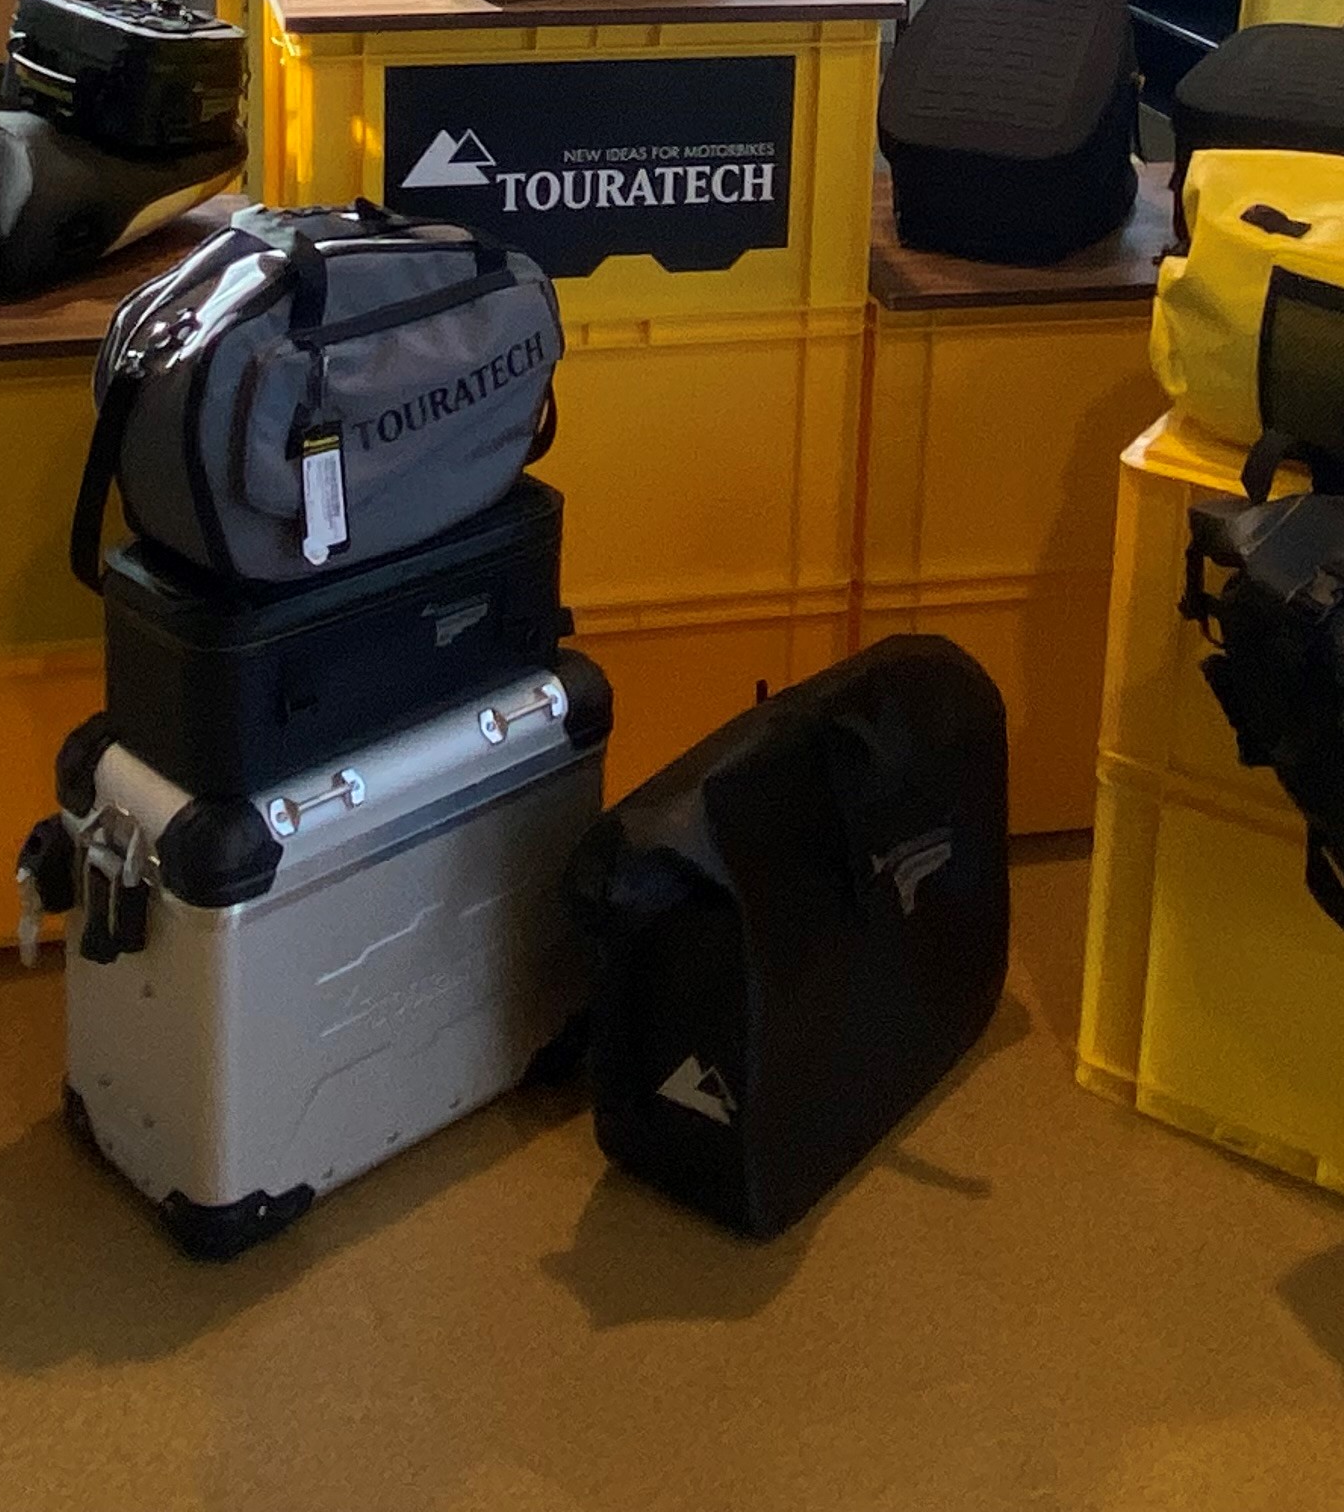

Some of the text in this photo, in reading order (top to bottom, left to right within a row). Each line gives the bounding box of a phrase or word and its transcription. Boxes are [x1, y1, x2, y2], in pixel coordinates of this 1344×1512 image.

[562, 141, 776, 164] NEW IDEAS FOR MOTORBIKES
[496, 162, 776, 212] TOURATECH
[352, 331, 545, 452] TOURATECH
